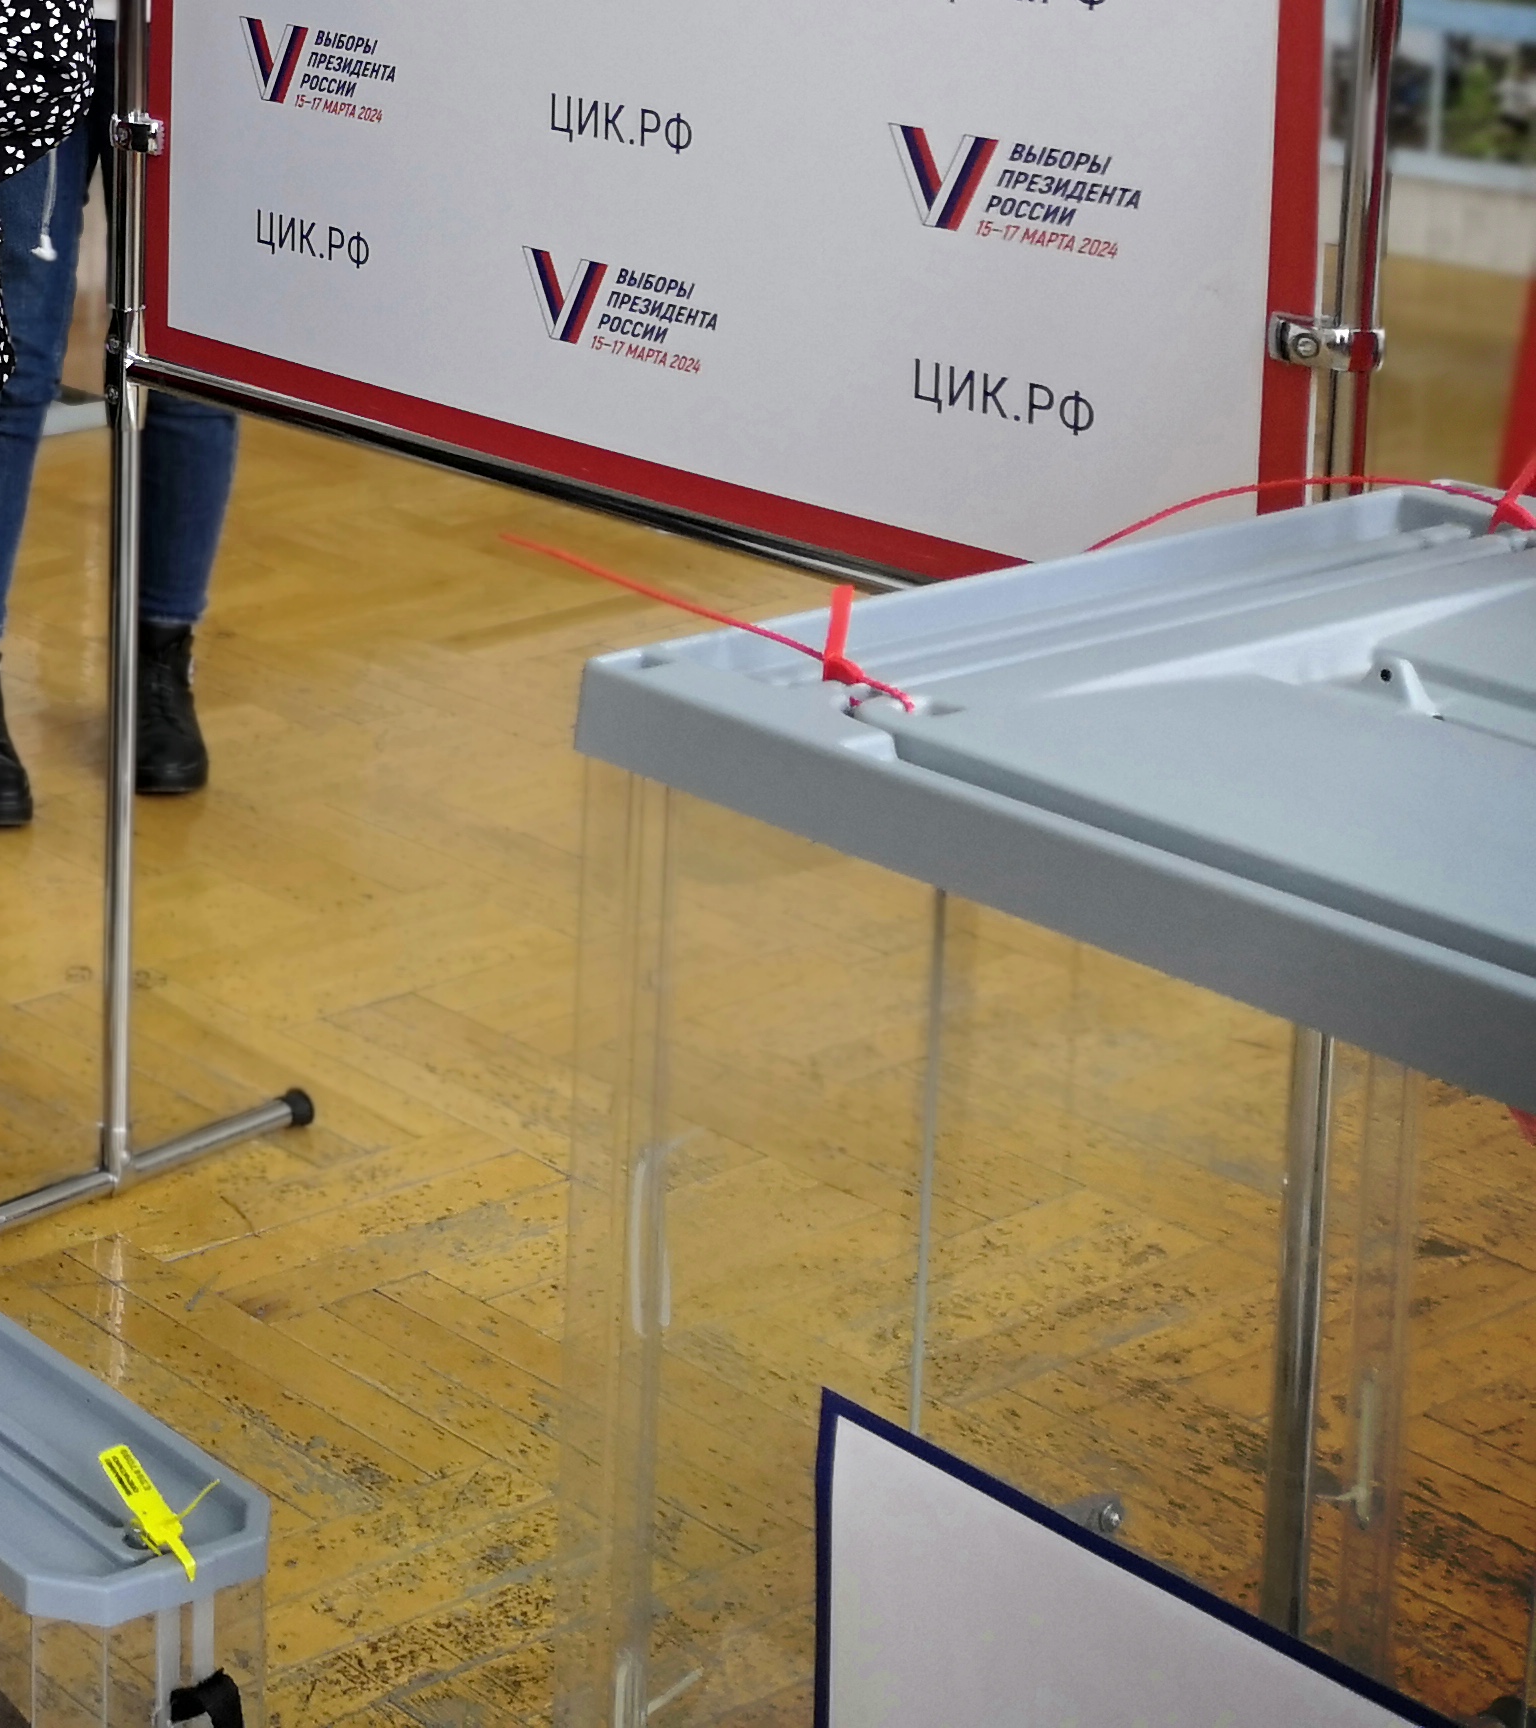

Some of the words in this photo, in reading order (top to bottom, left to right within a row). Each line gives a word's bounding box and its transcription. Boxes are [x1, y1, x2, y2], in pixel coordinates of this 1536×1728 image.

[314, 30, 378, 55] ВЫБОРЫ
[307, 52, 396, 82] ПРЕЗИДЕНТА
[299, 73, 357, 97] РОССИИ
[322, 99, 356, 118] МАРТА
[357, 105, 383, 122] 2024
[549, 91, 694, 156] ЦИК.РФ
[1009, 143, 1112, 175] ВЫБОРЫ
[997, 169, 1142, 209] ПРЕЗИДЕНТА
[985, 195, 1077, 227] РОССИИ
[256, 208, 371, 271] ЦИК.РФ
[1020, 227, 1076, 252] МАРТА
[1077, 237, 1119, 260] 2024
[615, 268, 695, 299] ВЫБОРЫ
[606, 291, 718, 331] ПРЕЗИДЕНТА
[597, 313, 669, 344] РОССИИ
[625, 343, 669, 367] МАРТА
[669, 353, 701, 374] 2024
[912, 357, 1097, 437] ЦИК.РФ
